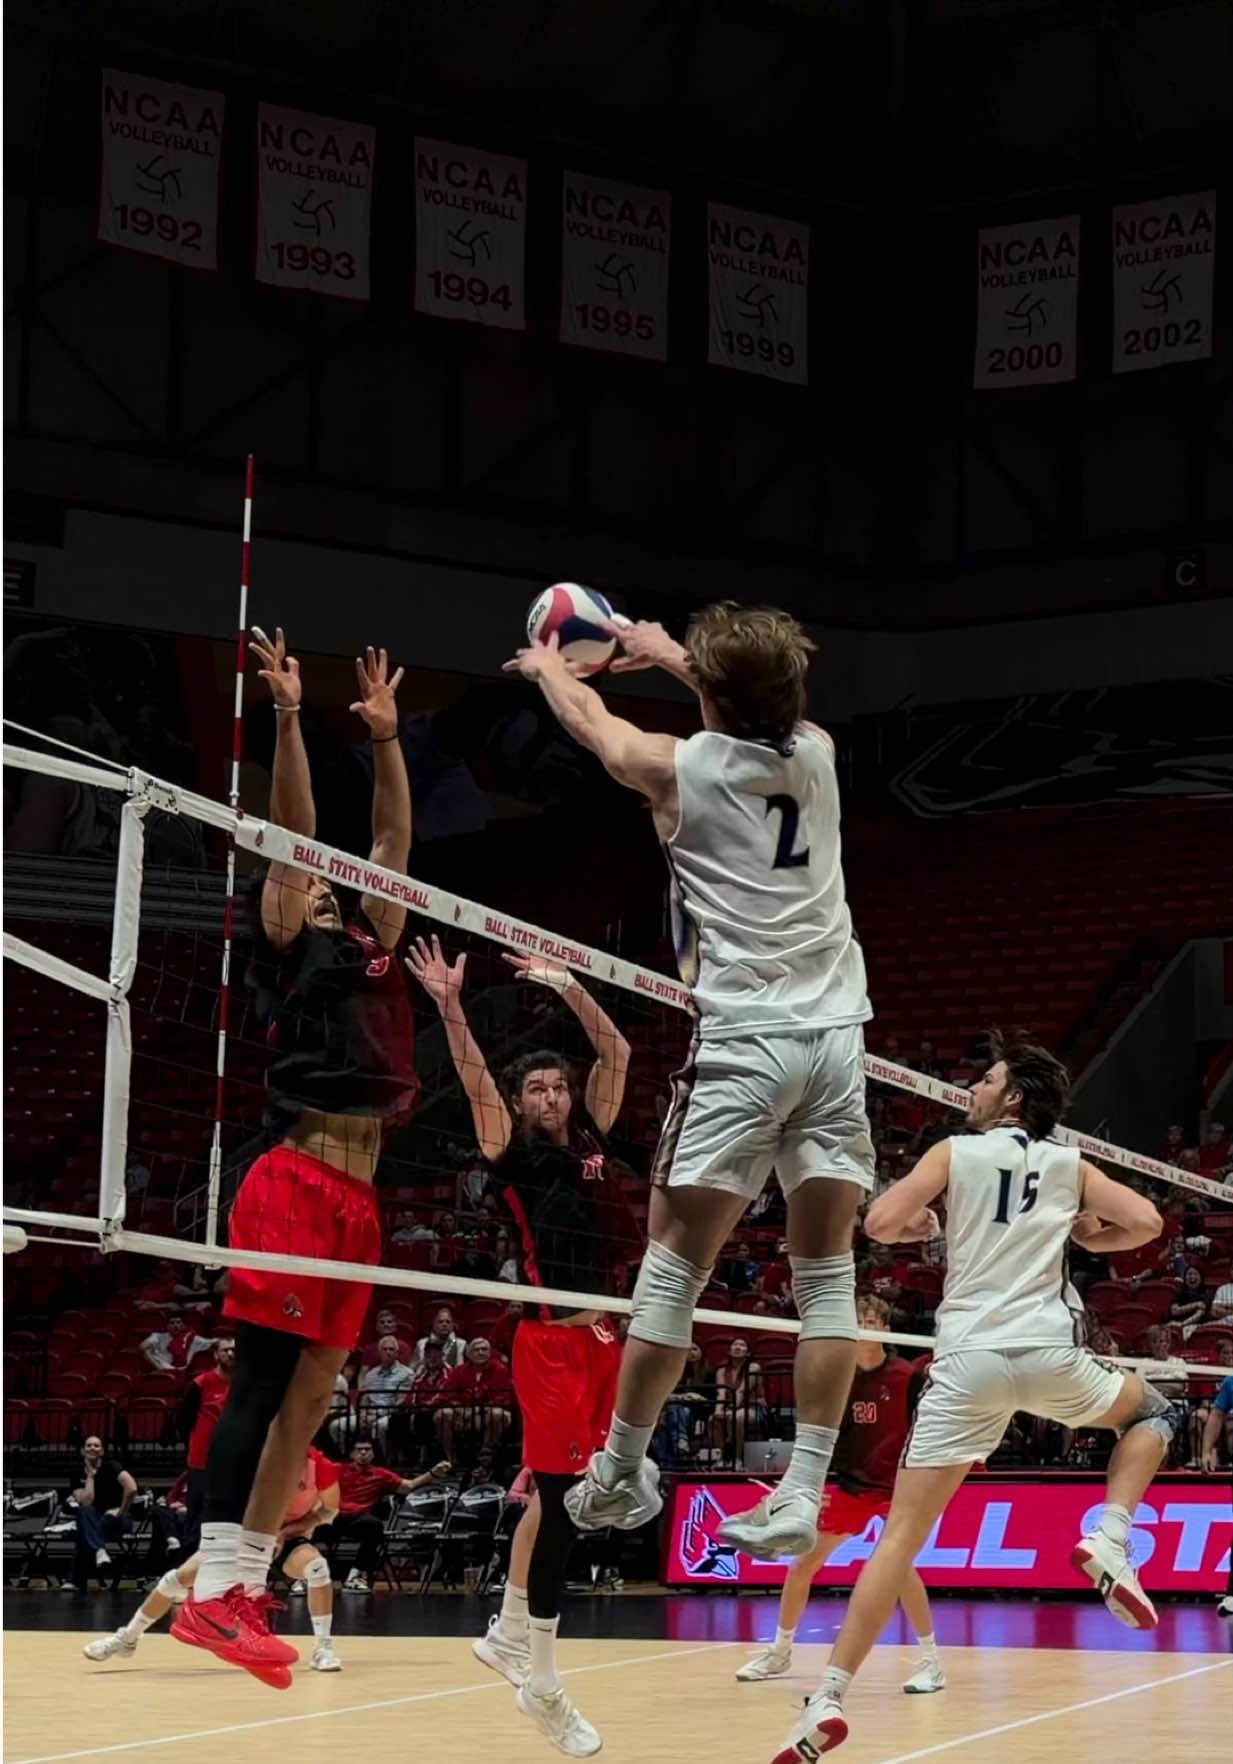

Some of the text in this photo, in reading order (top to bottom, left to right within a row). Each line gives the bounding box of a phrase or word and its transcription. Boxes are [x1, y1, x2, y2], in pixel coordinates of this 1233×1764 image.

[105, 87, 218, 136] NCAA
[109, 121, 214, 157] VOLLEYBALL
[261, 122, 370, 168] NCAA
[266, 155, 366, 188] VOLLEYBALL
[417, 153, 522, 200] NCAA
[423, 188, 518, 221] VOLLEYBALL
[566, 188, 666, 232] NCAA
[114, 205, 202, 249] 1992
[567, 219, 666, 254] VOLLEYBALL
[710, 219, 804, 265] NCAA
[1116, 208, 1212, 247] NCAA
[271, 243, 355, 279] 1993
[711, 251, 804, 285] VOLLEYBALL
[981, 232, 1075, 270] NCAA
[1116, 240, 1211, 268] VOLLEYBALL
[428, 271, 512, 311] 1994
[981, 264, 1075, 288] VOLLEYBALL
[576, 304, 654, 340] 1995
[1124, 319, 1201, 355] 2002
[720, 329, 794, 366] 1999
[989, 342, 1062, 372] 2000
[1175, 560, 1198, 586] C
[764, 794, 809, 870] 2
[293, 844, 429, 909] BALL STATE VOLLEYBALL
[485, 917, 592, 968] BALL STATE VOLLEYBALL
[635, 973, 653, 992] BALL
[655, 982, 678, 1001] STATE
[993, 1167, 1039, 1224] 15
[751, 1502, 1038, 1570] ALL
